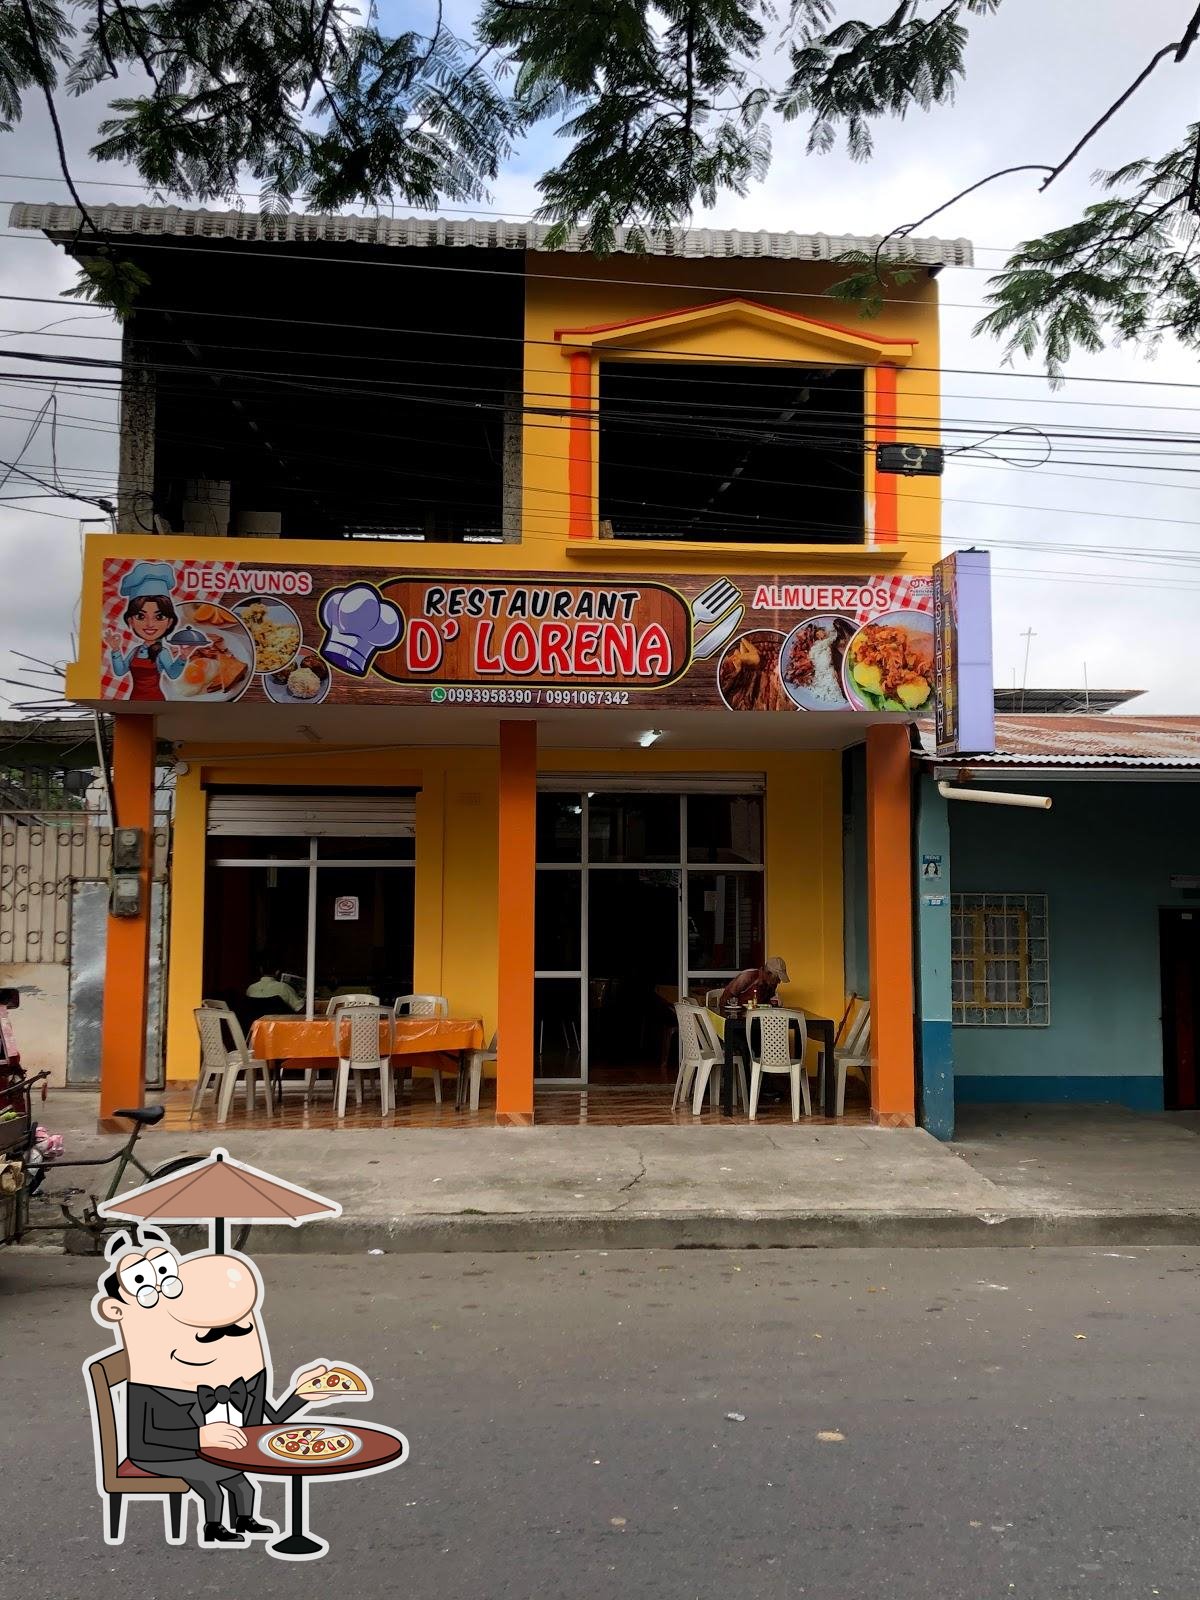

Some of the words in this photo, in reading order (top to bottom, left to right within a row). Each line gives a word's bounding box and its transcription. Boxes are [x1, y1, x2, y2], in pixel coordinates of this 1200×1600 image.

[186, 571, 310, 592] DESAYUNOS
[424, 587, 640, 620] RESTAURANT
[754, 587, 888, 608] ALMUERZOS
[474, 620, 672, 677] LORENA
[448, 689, 532, 704] 0993958390
[536, 691, 542, 704] /
[546, 691, 629, 705] 0991067342
